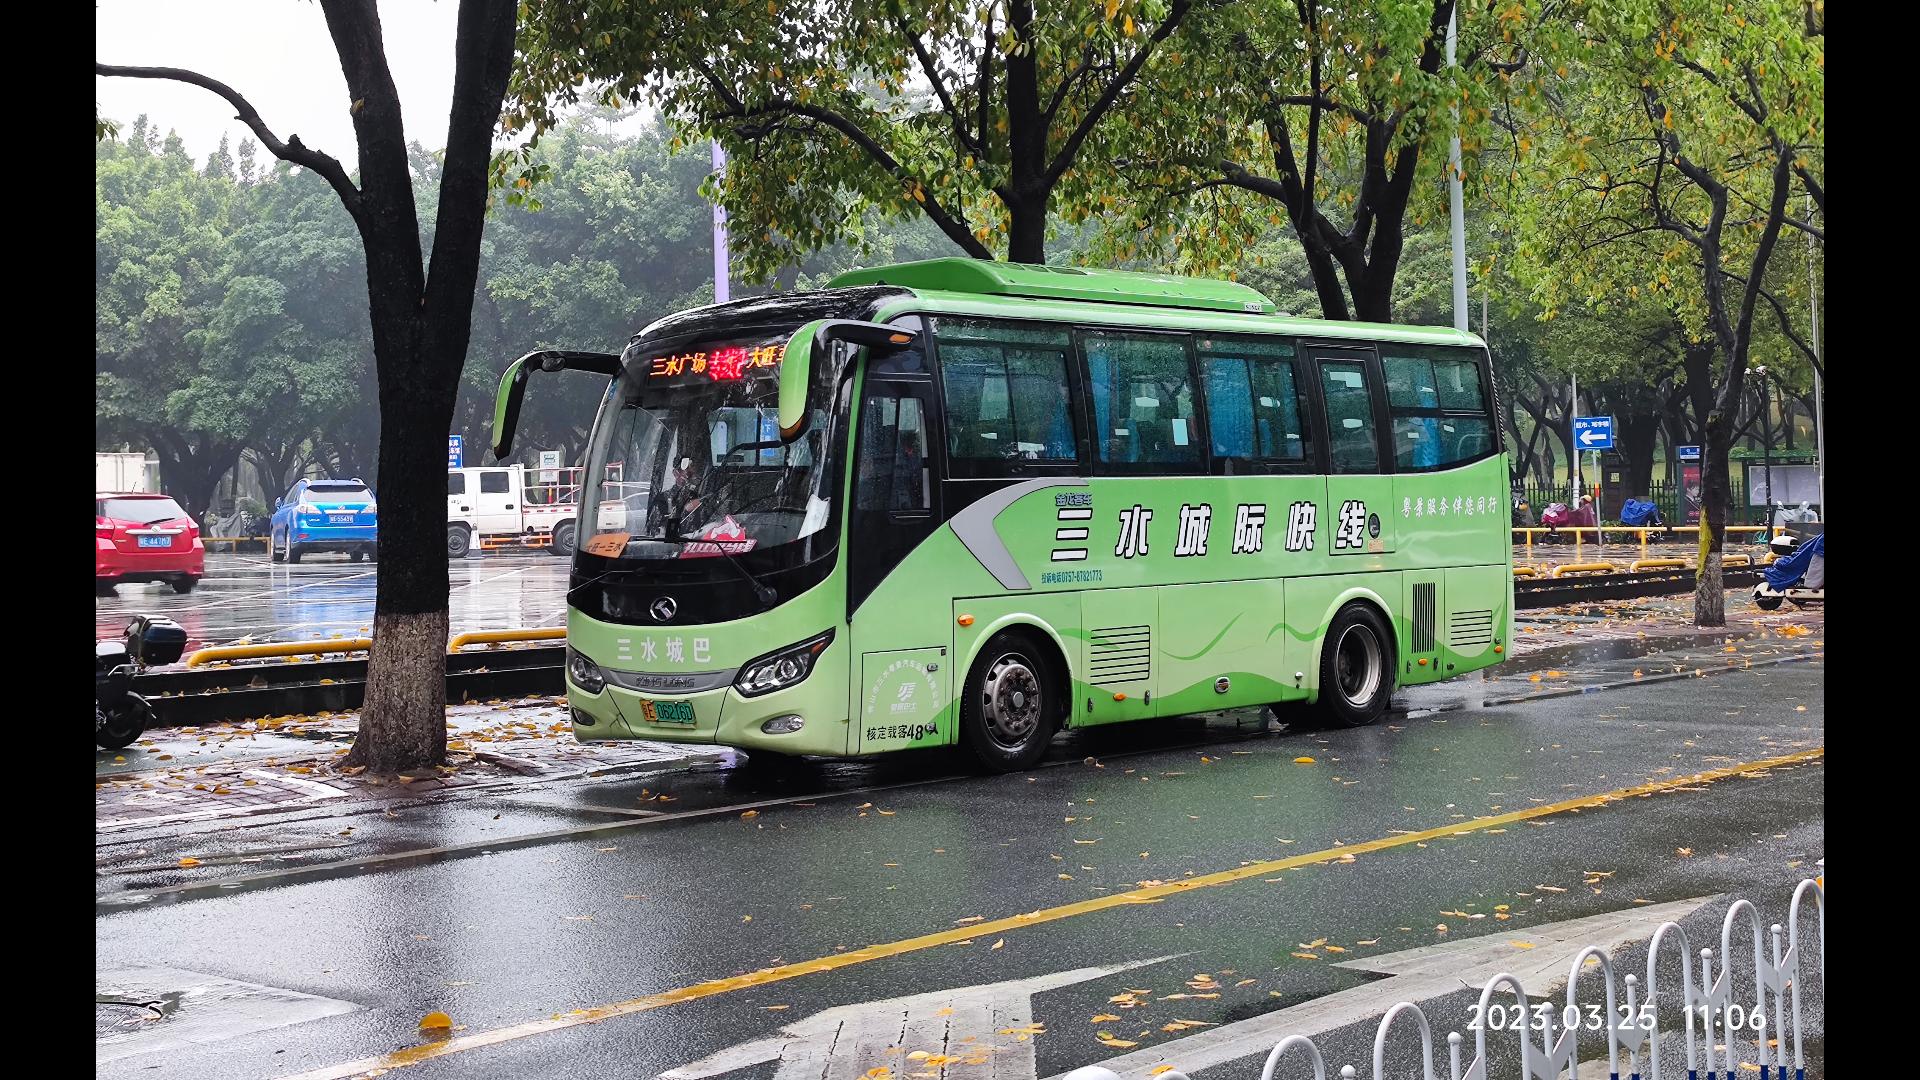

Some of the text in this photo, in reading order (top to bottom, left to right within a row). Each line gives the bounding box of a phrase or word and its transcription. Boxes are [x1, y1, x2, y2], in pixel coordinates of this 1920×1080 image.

[650, 352, 706, 376] 三水广场
[1401, 496, 1498, 518] 粤景服务伴您同行
[1051, 500, 1366, 562] 三水城际快线
[617, 637, 712, 664] 三水城巴
